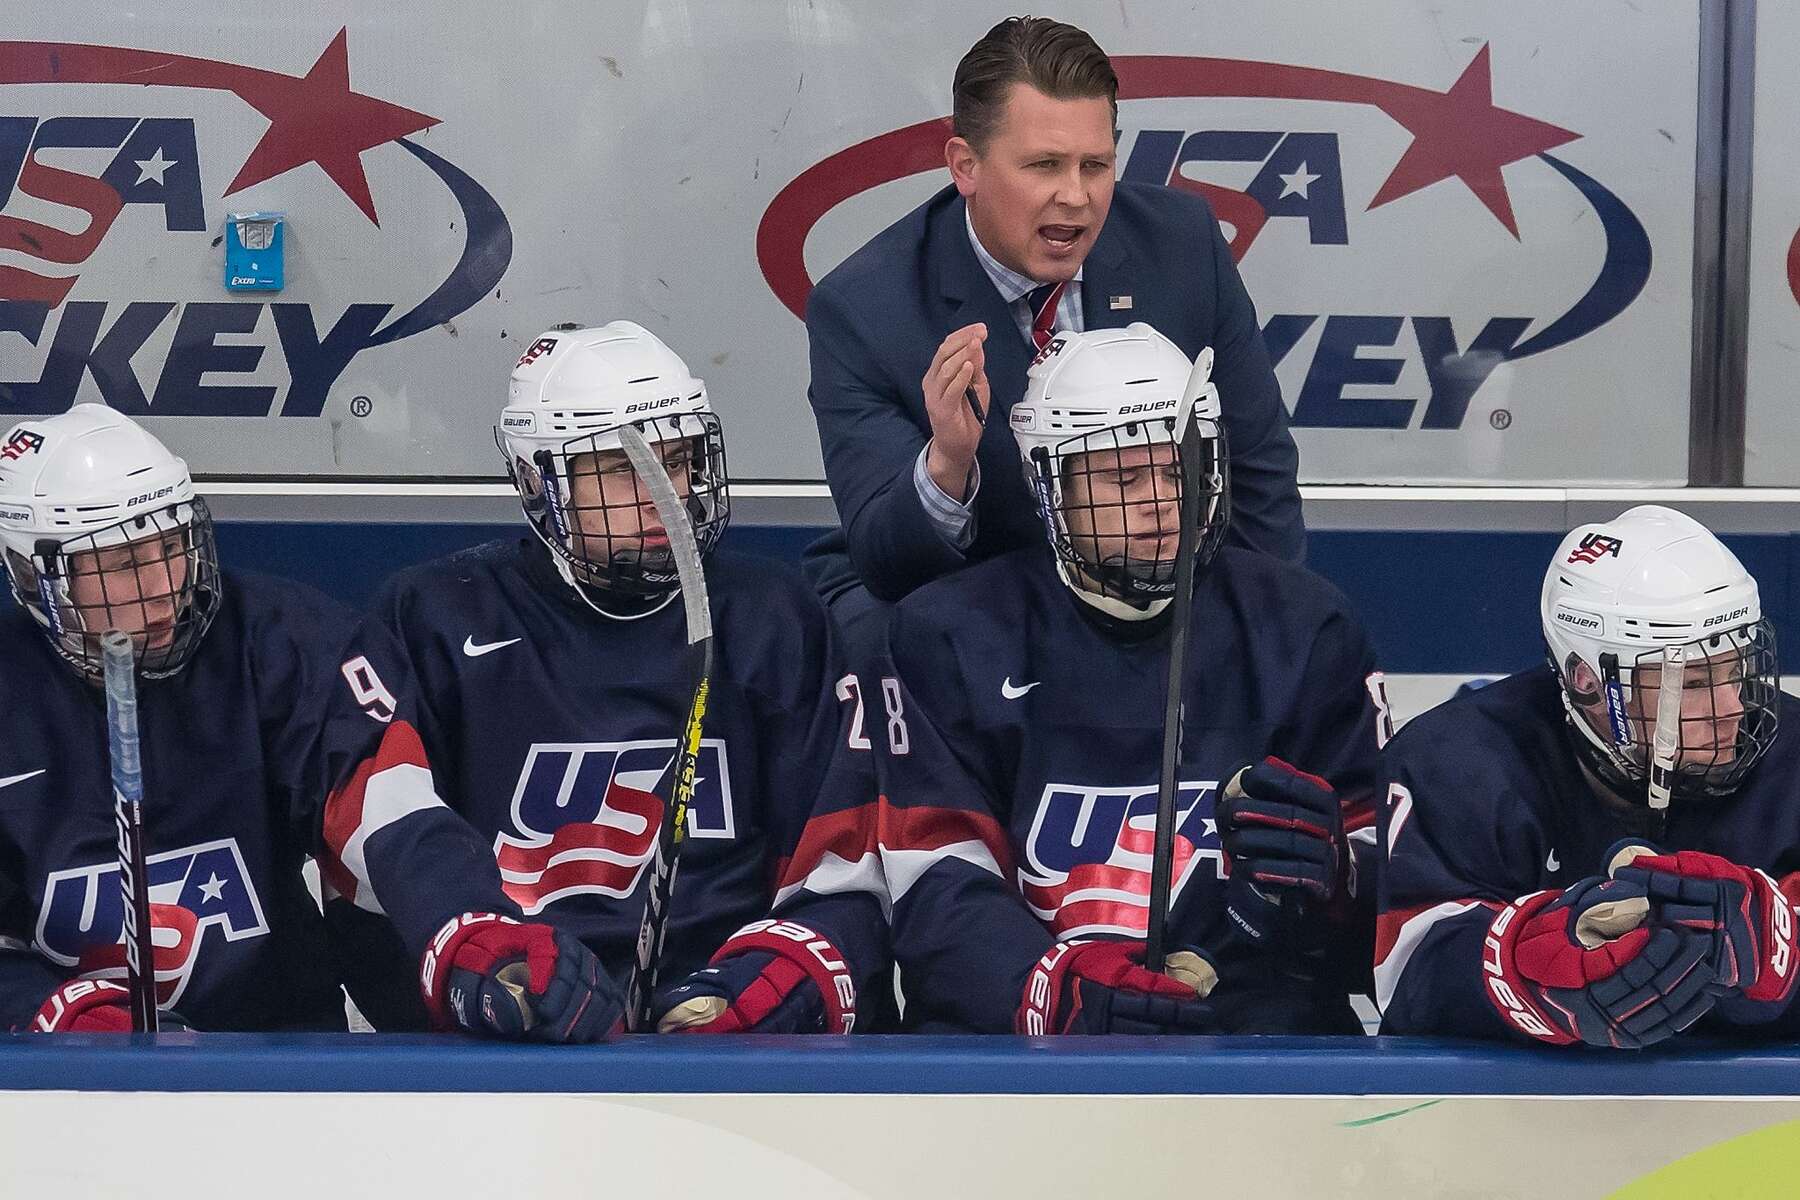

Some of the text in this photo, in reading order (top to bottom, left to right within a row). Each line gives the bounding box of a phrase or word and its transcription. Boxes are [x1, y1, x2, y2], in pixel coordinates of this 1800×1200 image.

[624, 396, 681, 414] BAUER
[1118, 399, 1177, 416] BAUER
[503, 418, 532, 427] BAUER
[126, 485, 175, 508] BAUER
[545, 479, 568, 537] BAUER
[0, 510, 30, 521] AUER
[1567, 532, 1623, 565] USA
[42, 578, 65, 636] BAUER
[1556, 612, 1600, 630] BAUER
[1702, 605, 1749, 629] BAUER
[341, 655, 397, 723] 9
[835, 673, 872, 750] 2
[881, 677, 909, 755] 8
[1609, 686, 1630, 746] BAUER
[493, 738, 736, 917] USA
[1386, 782, 1414, 864] 7
[1227, 905, 1261, 938] BAUER
